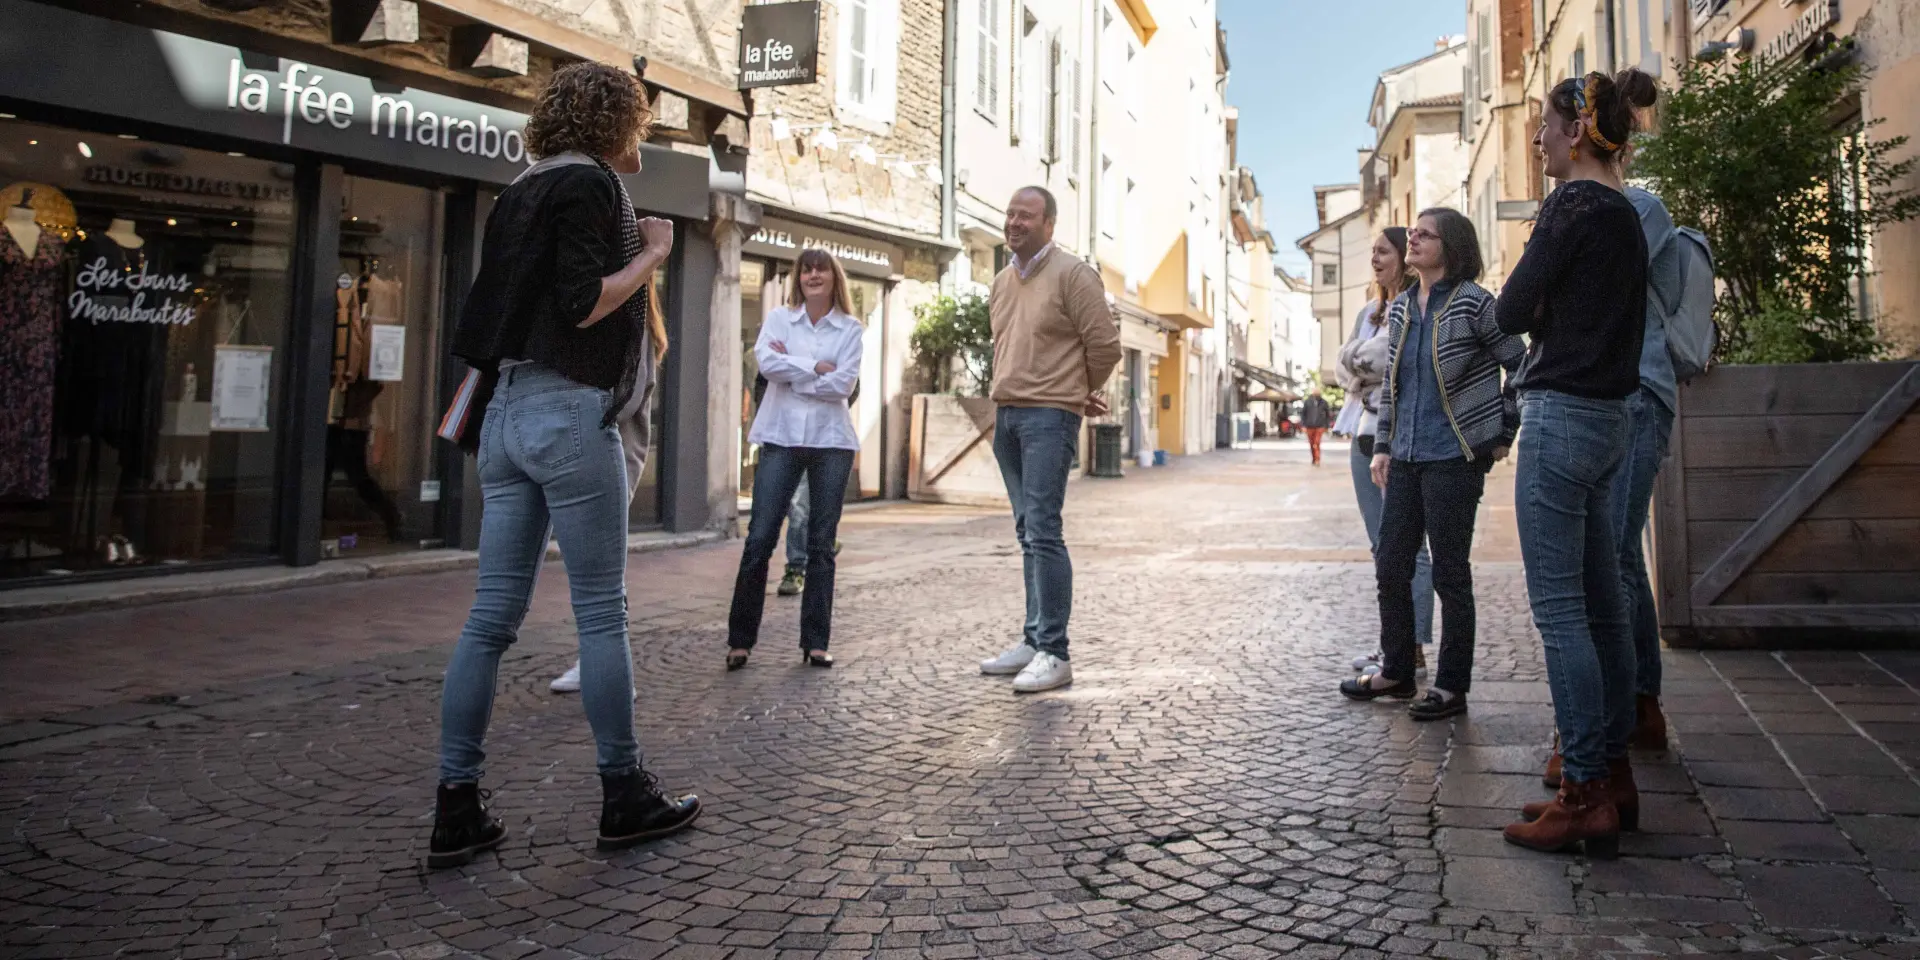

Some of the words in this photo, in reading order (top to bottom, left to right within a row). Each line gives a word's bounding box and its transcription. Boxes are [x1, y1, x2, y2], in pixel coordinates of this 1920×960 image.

[744, 60, 809, 82] maraboutée
[745, 44, 761, 64] la
[763, 38, 794, 73] fée
[227, 58, 270, 113] la
[278, 62, 354, 144] fée
[802, 235, 890, 267] PARTICULIER
[76, 256, 123, 292] Les
[125, 260, 192, 292] Jours
[68, 290, 197, 326] Maraboutés
